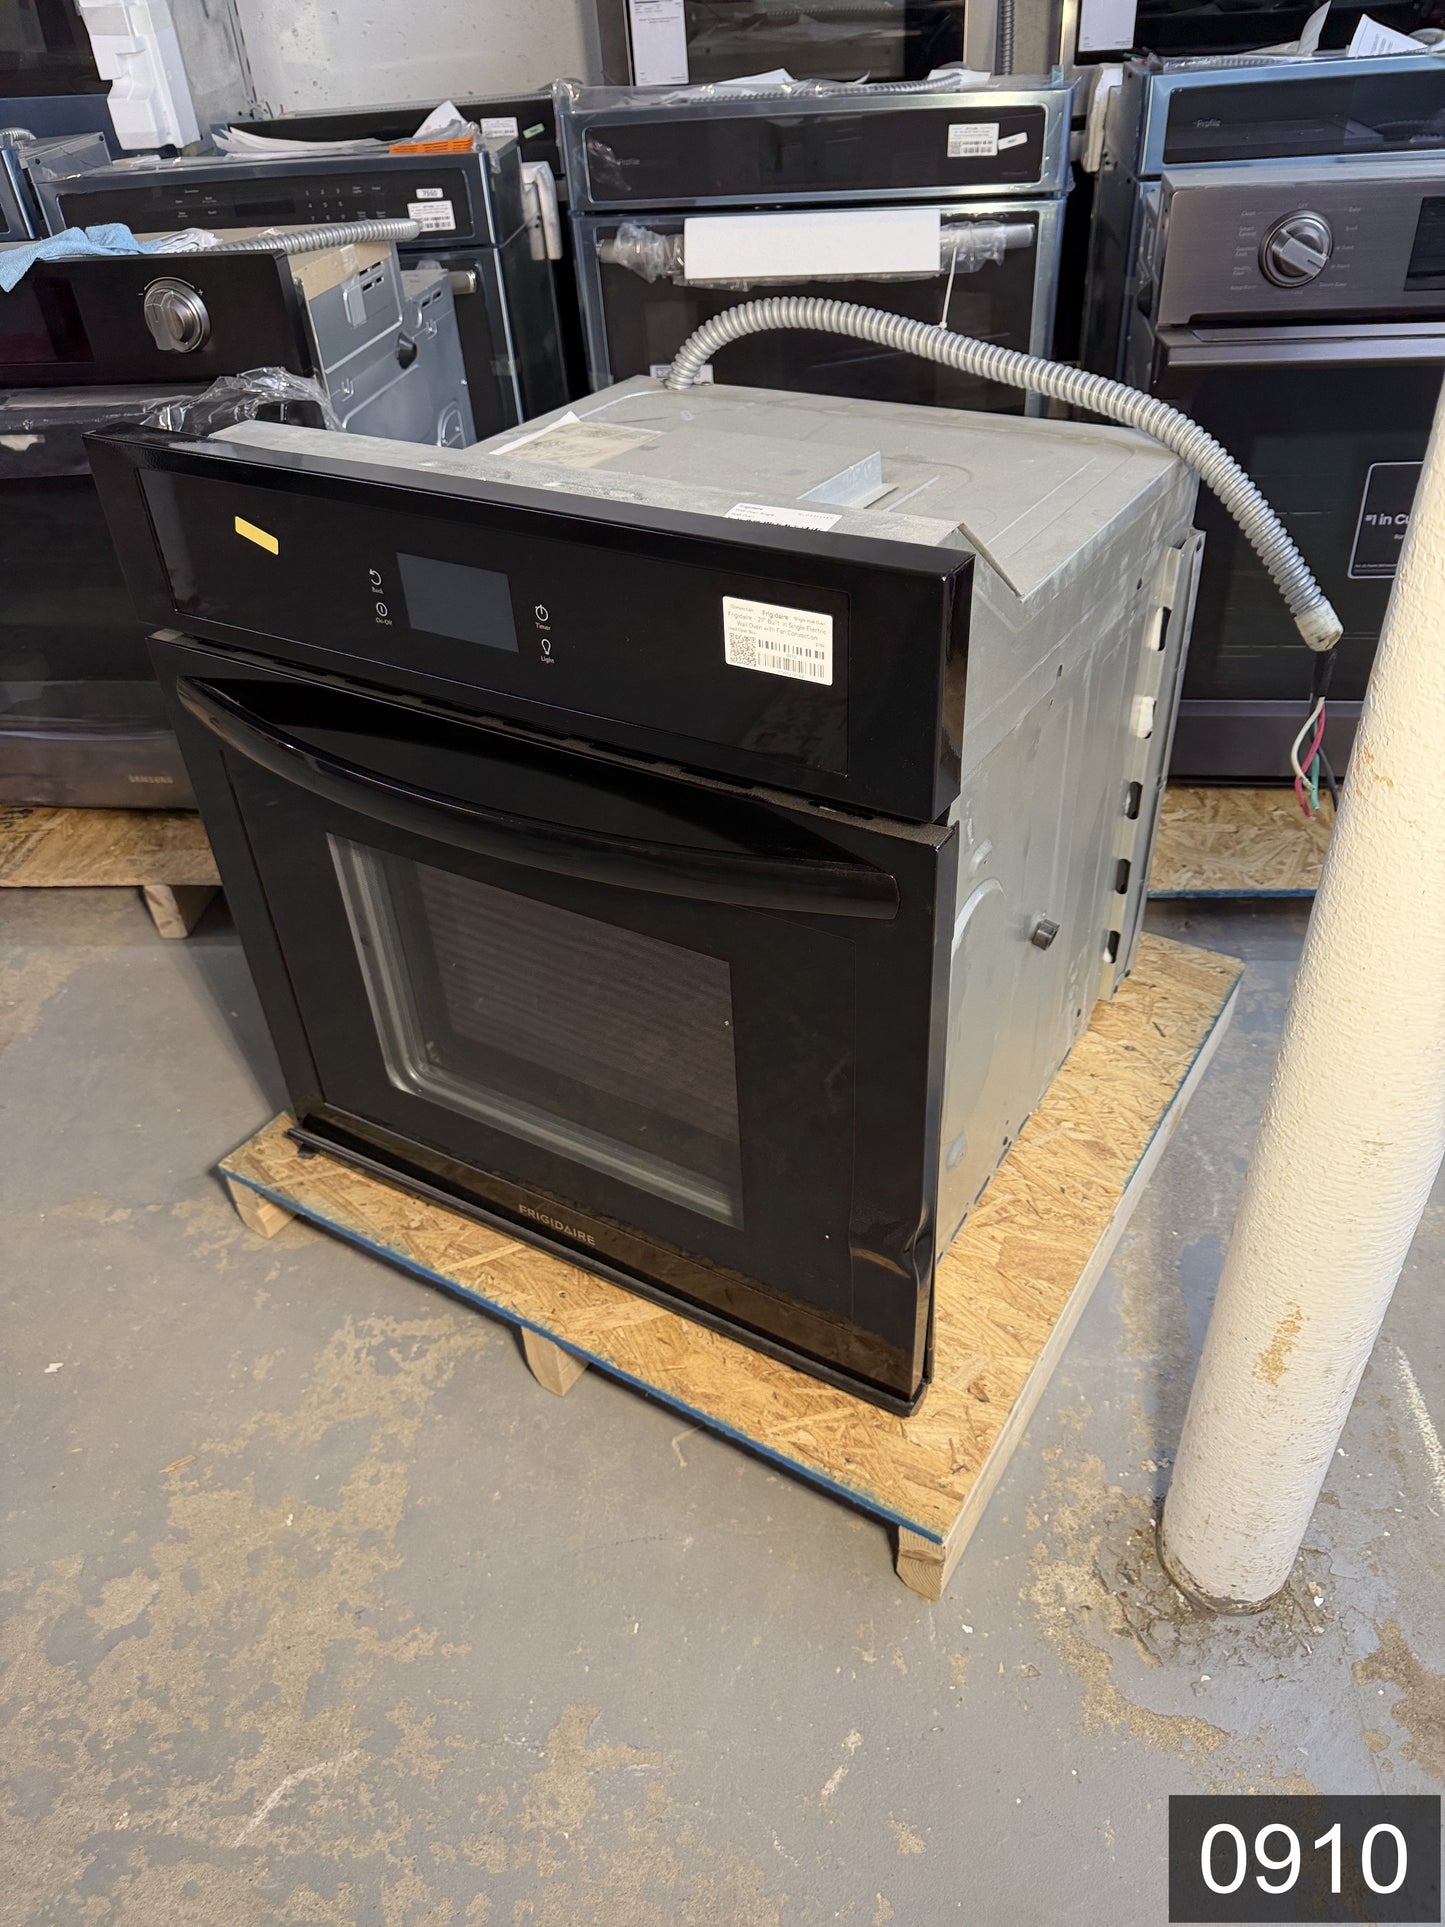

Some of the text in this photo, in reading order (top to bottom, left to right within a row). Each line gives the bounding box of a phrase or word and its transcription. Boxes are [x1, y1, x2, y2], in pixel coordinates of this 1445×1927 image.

[1378, 512, 1393, 526] in
[762, 609, 789, 621] Frigidaire
[535, 621, 551, 631] Timer
[787, 629, 818, 641] Convection
[540, 655, 555, 664] Light
[518, 1203, 597, 1247] FRIGIDAIRE
